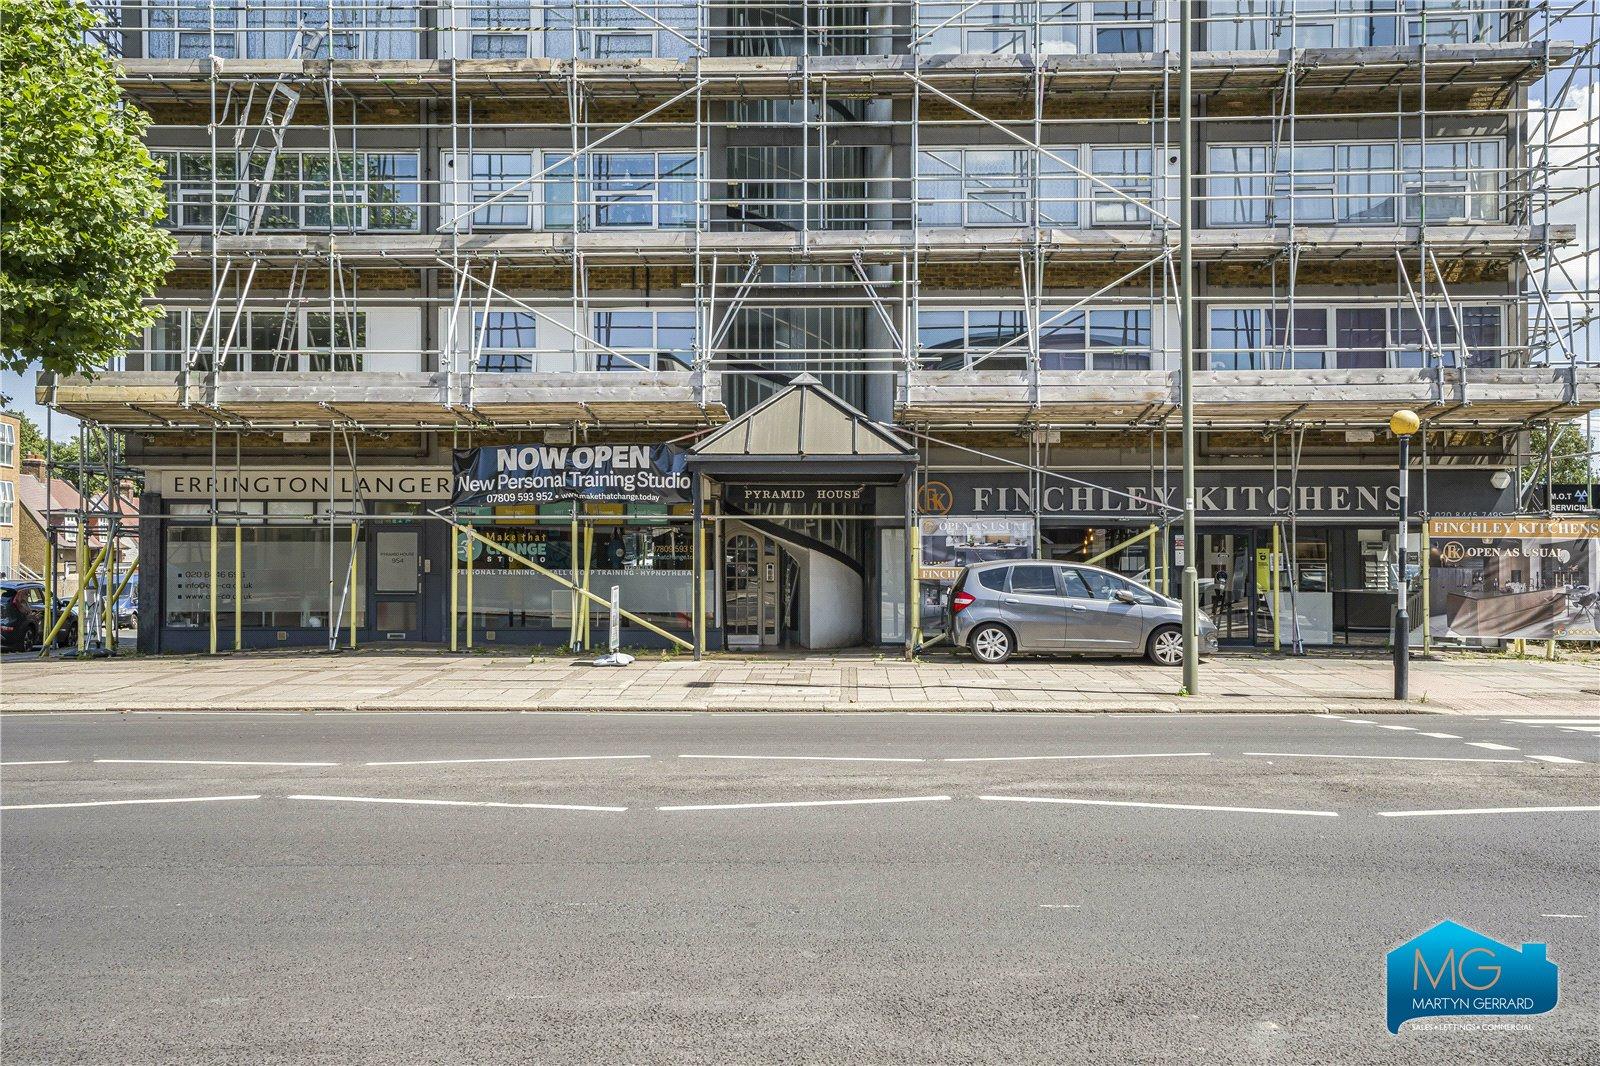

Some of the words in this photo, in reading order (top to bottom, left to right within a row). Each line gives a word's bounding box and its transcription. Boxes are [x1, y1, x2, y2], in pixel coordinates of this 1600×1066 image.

[497, 446, 569, 471] NOW
[572, 446, 650, 469] OPEN
[174, 477, 328, 493] ERRINGTON
[341, 477, 451, 493] LANGER
[458, 475, 495, 492] New
[497, 472, 566, 490] Personal
[569, 470, 635, 492] Training
[637, 471, 691, 489] Studio
[486, 493, 516, 503] 07809
[517, 492, 534, 501] 593
[536, 491, 553, 501] 952
[561, 492, 660, 502] www.makethatchange.today
[744, 490, 805, 499] PYRAMID
[817, 490, 860, 499] HOUSE
[971, 486, 1177, 512] FINCHLEY
[1194, 486, 1400, 511] KITCHENS
[1550, 504, 1588, 512] SERVICIN
[1434, 522, 1514, 534] FINCHLEY
[1518, 522, 1599, 534] KITCHENS
[486, 532, 516, 541] Make
[522, 532, 547, 541] that
[1467, 547, 1501, 557] OPEN
[1503, 547, 1520, 557] AS
[1523, 548, 1562, 558] USUAL
[922, 569, 958, 578] FINCH
